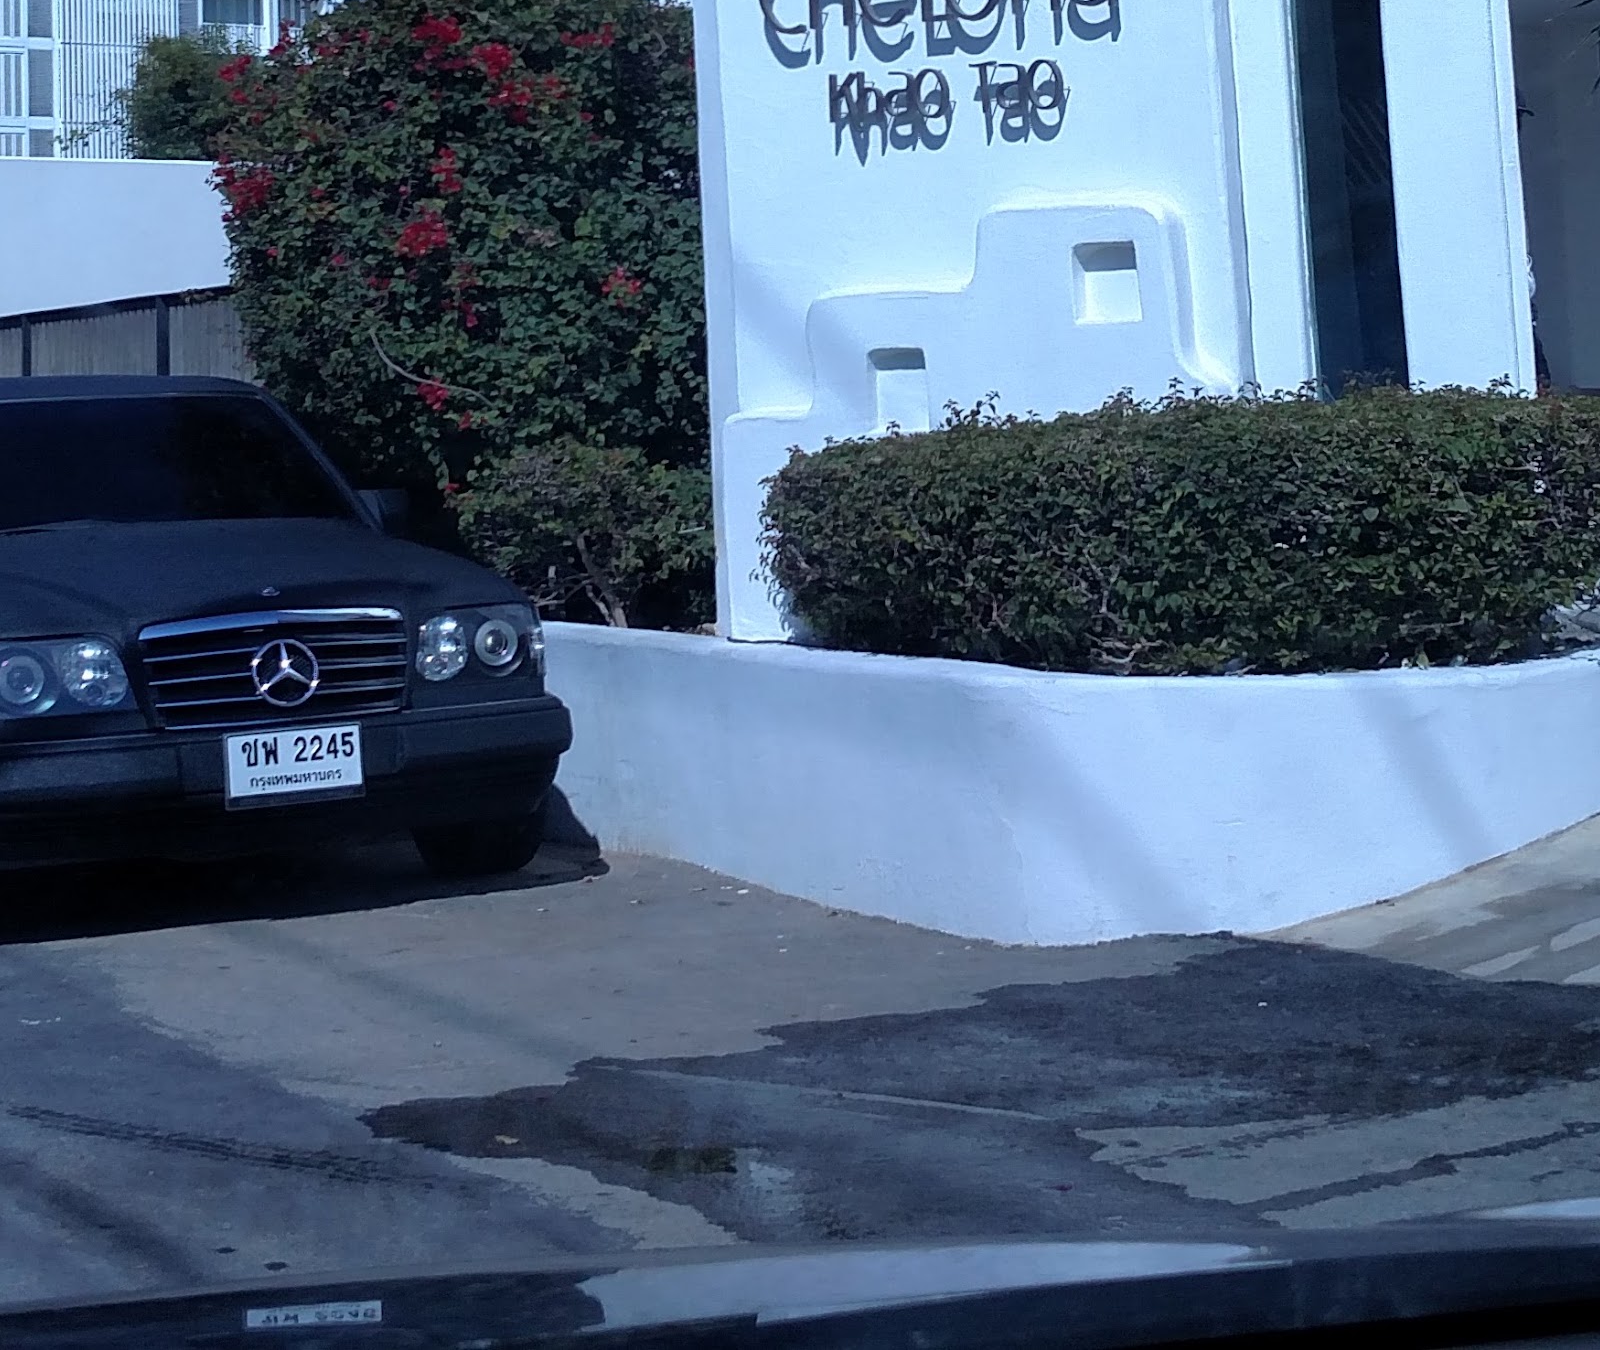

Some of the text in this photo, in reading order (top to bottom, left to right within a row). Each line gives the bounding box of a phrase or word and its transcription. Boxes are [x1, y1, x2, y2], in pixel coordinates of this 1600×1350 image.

[829, 59, 1065, 133] Khao Tao
[293, 731, 355, 763] 2245
[249, 769, 343, 791] กรุงเทพมหานคร
